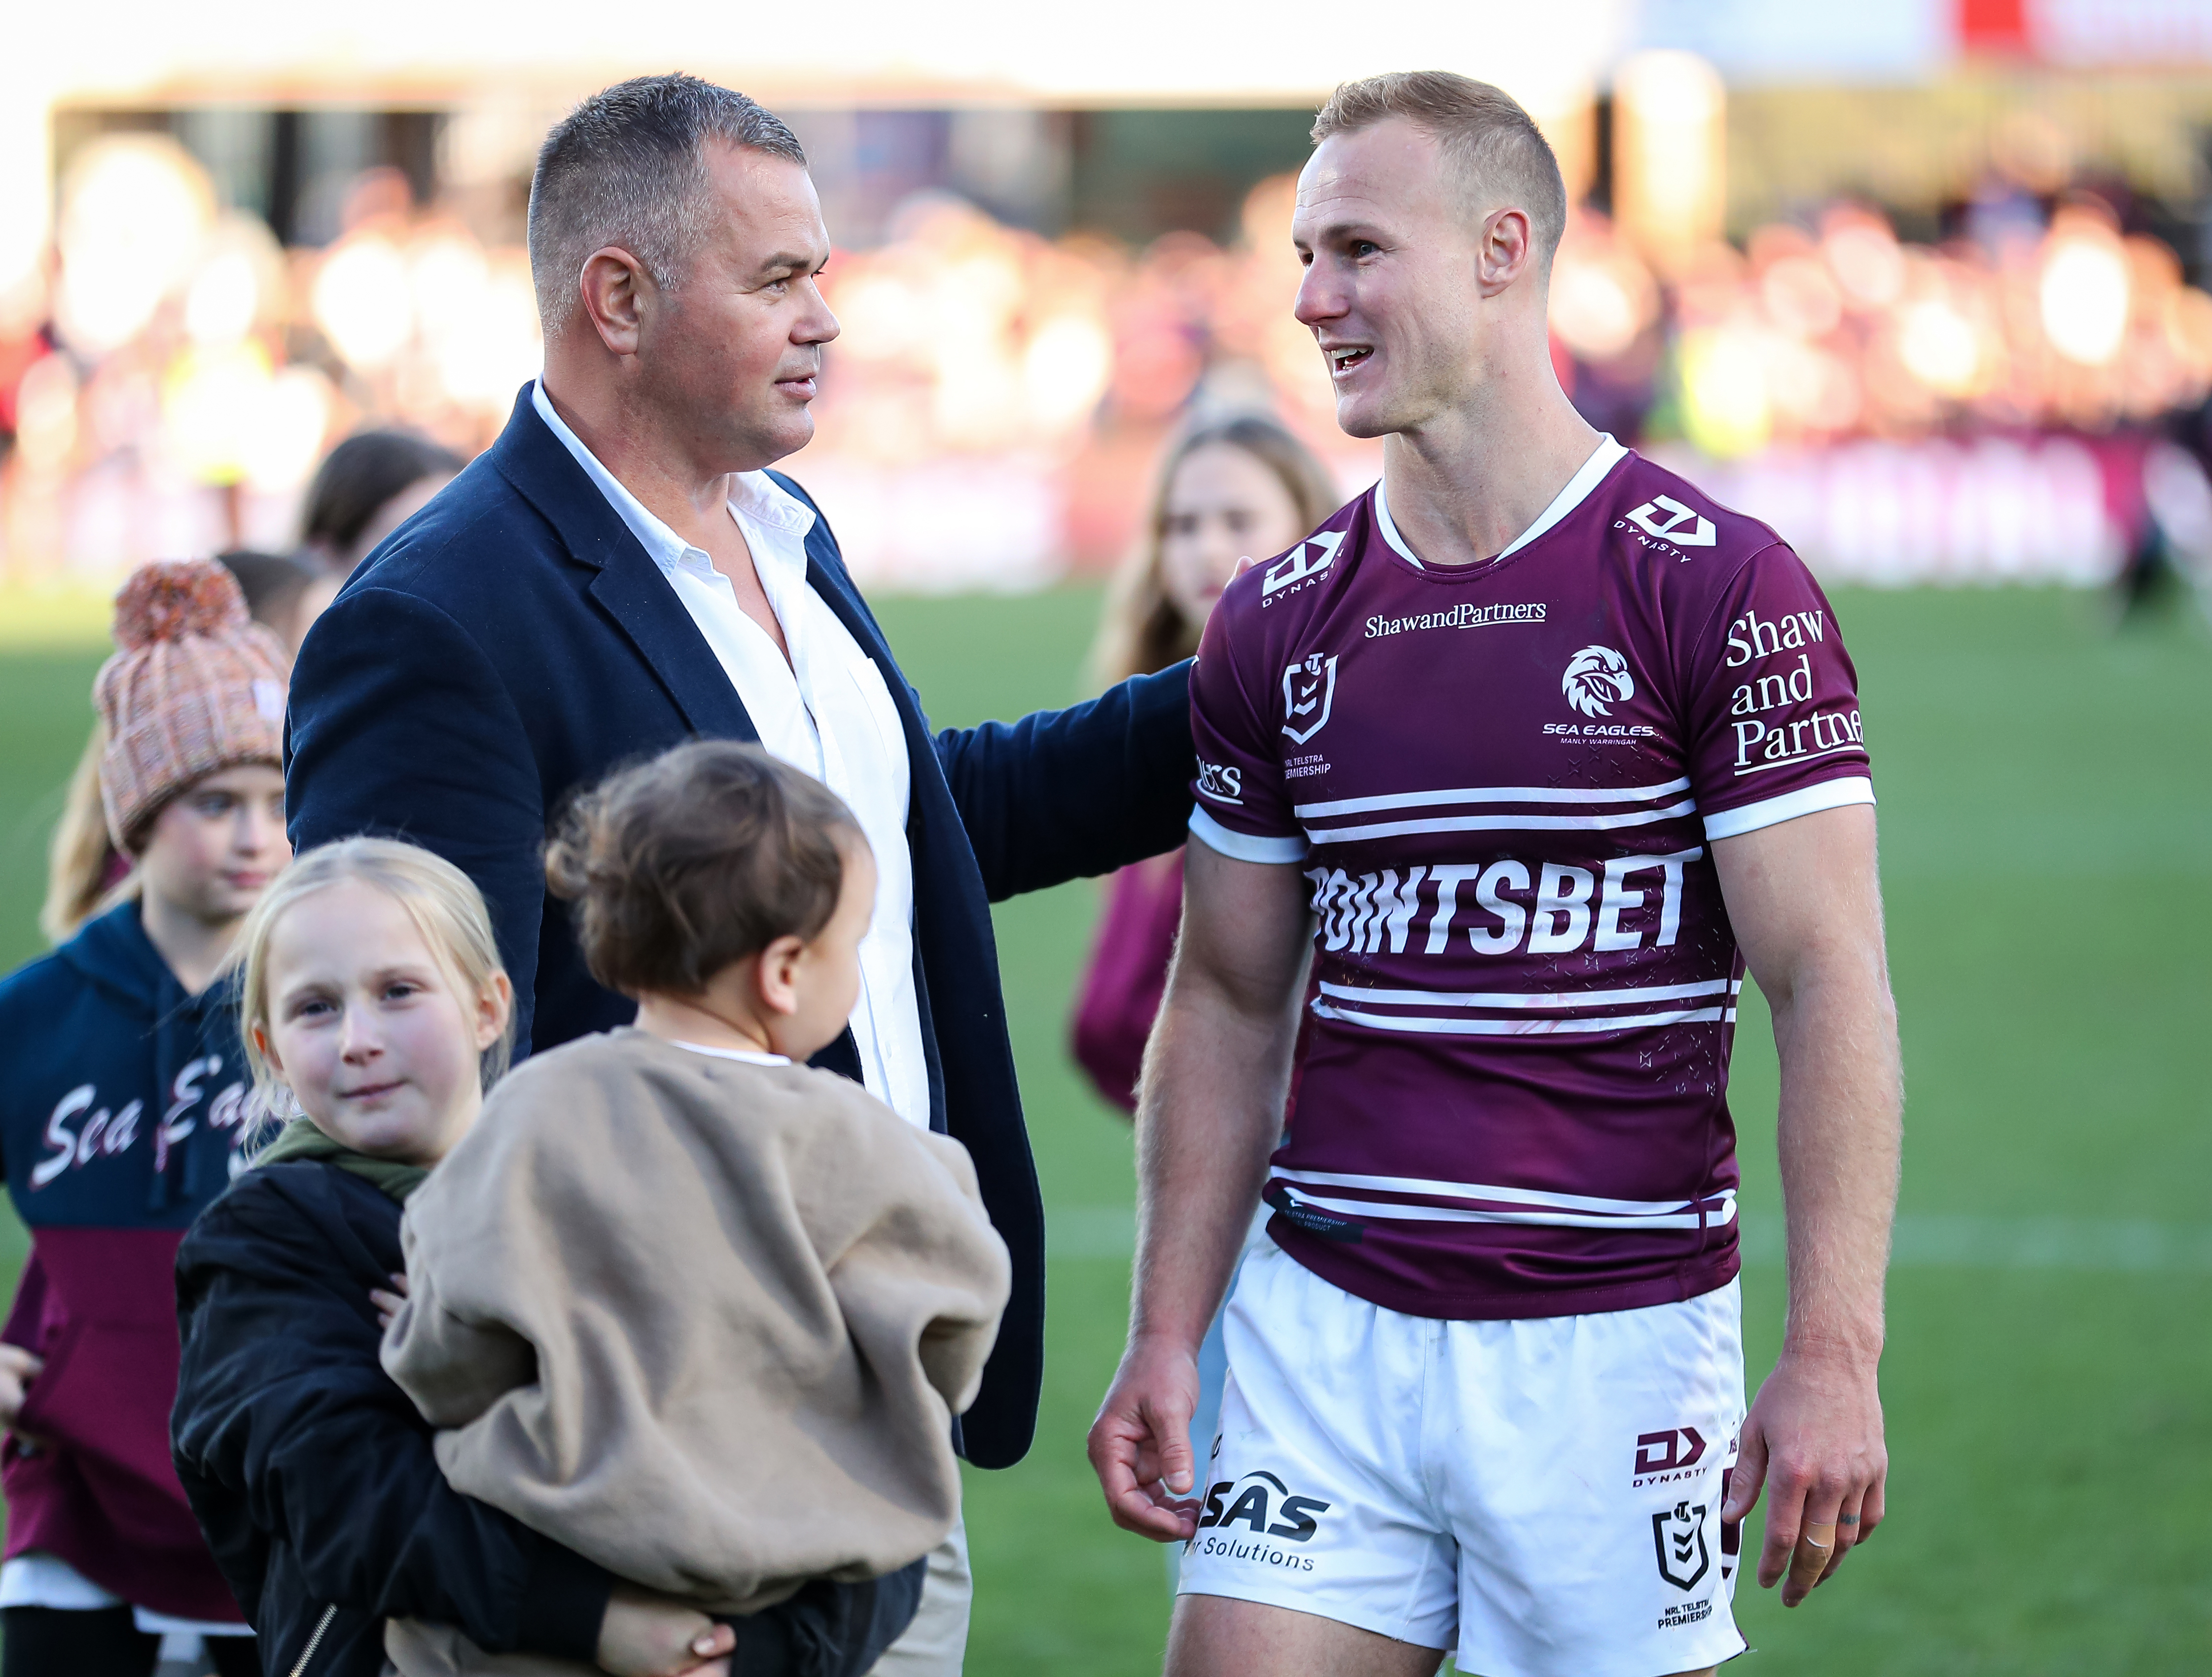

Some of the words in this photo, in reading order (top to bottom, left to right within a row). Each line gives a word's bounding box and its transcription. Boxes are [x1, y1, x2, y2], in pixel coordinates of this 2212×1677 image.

[1613, 520, 1691, 563] DYNASTY
[1726, 610, 1823, 667] Shaw
[1731, 654, 1813, 715] and
[1542, 724, 1579, 735] SEA
[1583, 725, 1654, 736] EAGLES
[1731, 710, 1864, 766] Partne
[1285, 763, 1331, 780] EMIERSHIP
[1293, 754, 1323, 766] TELSTRA
[31, 1083, 143, 1187] Sea
[1633, 1466, 1708, 1488] DYNASTY
[1199, 1481, 1331, 1542] SAS
[1204, 1536, 1315, 1571] Solutions
[1665, 1605, 1680, 1616] NRL
